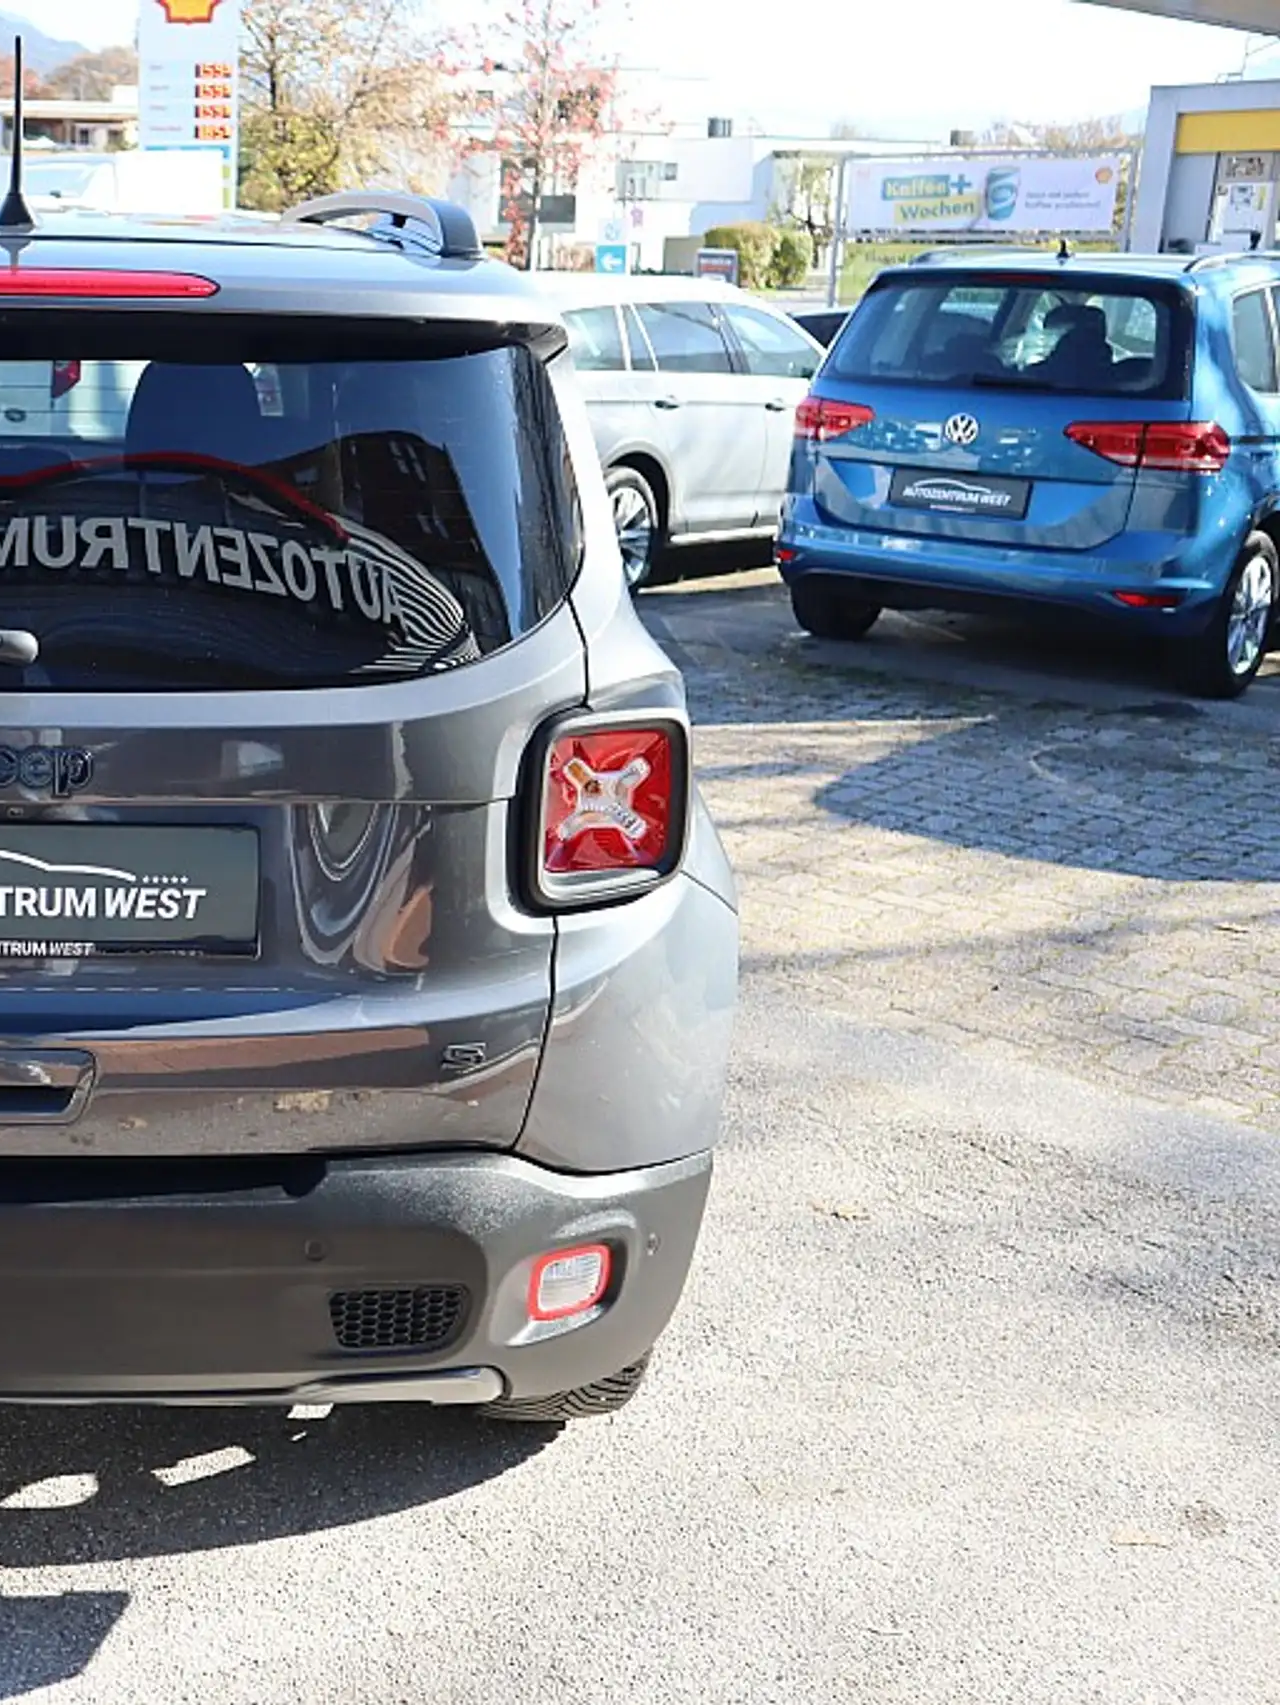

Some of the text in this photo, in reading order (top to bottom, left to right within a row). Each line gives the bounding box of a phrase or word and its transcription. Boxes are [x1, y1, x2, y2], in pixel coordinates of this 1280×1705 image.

[900, 202, 974, 220] Wochen
[104, 885, 207, 920] WEST
[48, 941, 95, 957] WEST
